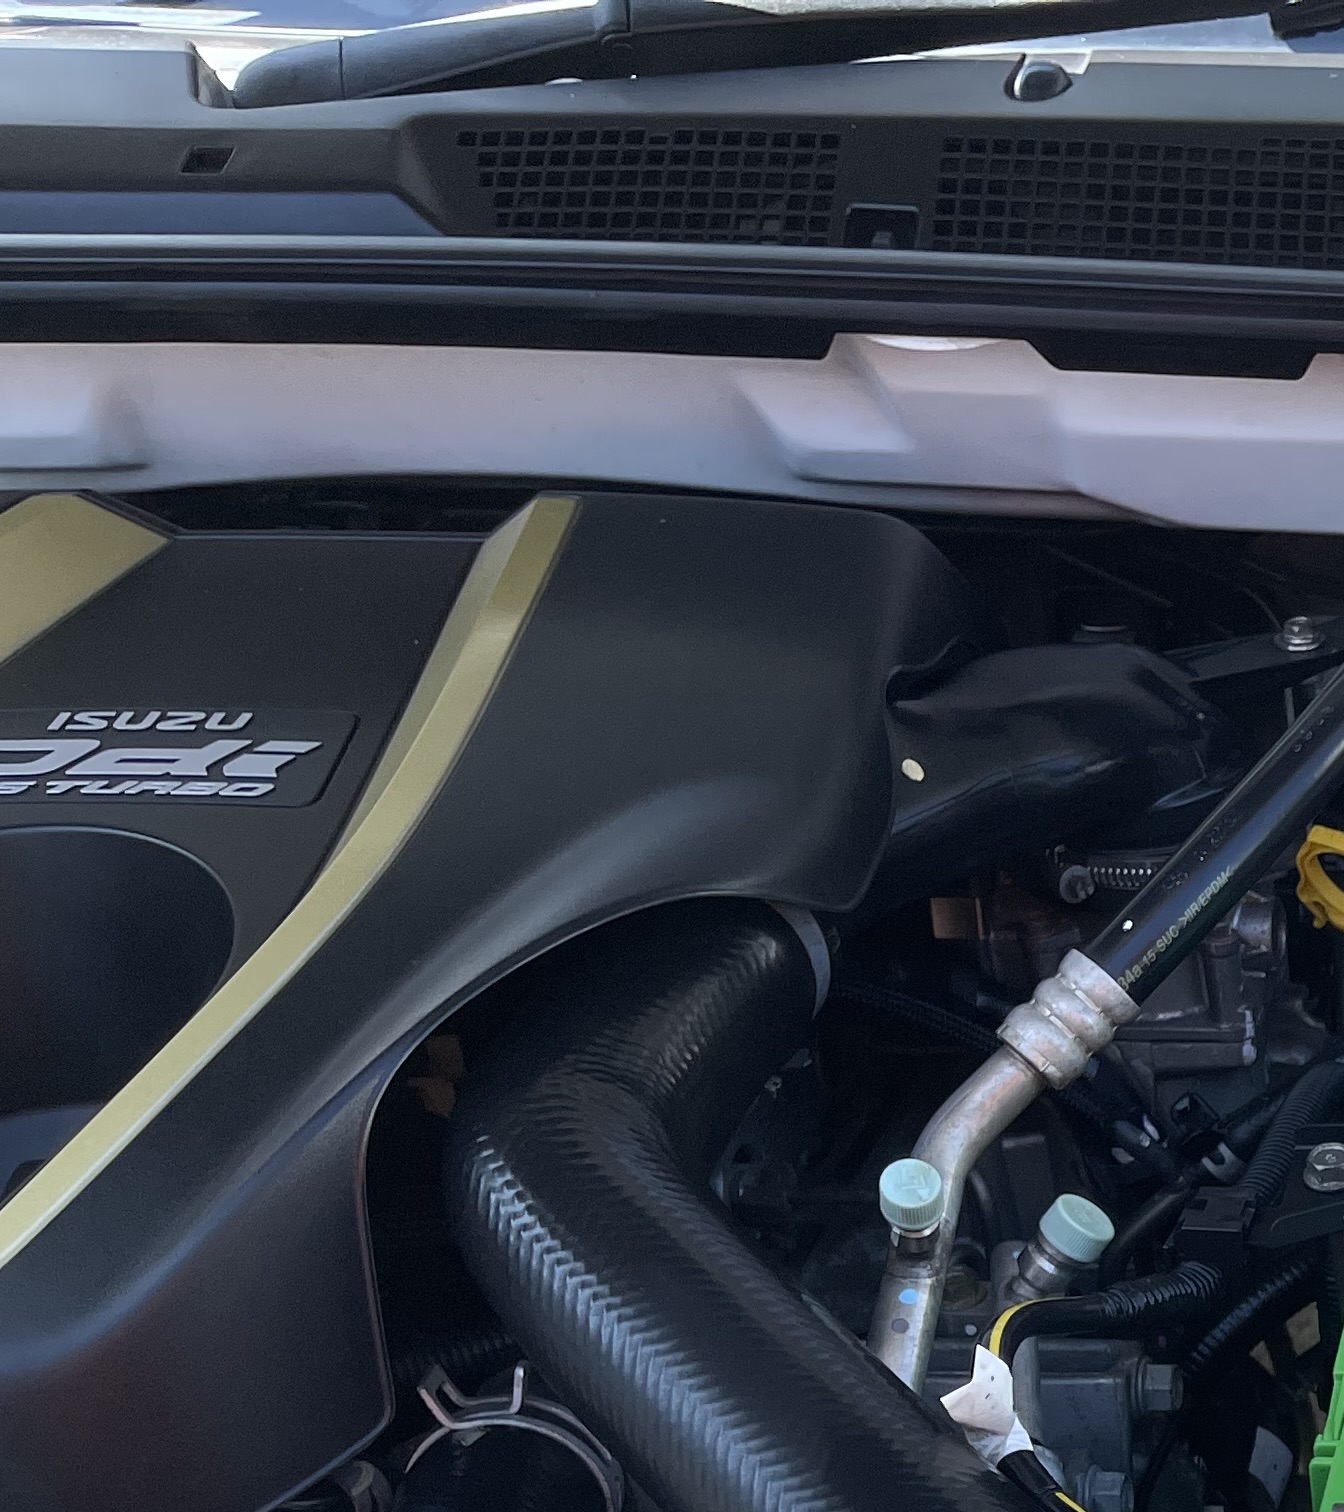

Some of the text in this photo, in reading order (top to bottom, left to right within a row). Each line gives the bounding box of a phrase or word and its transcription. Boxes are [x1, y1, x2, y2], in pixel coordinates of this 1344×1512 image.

[47, 711, 254, 732] ISUZU
[46, 779, 275, 797] TURBO
[1141, 949, 1157, 966] 15
[1153, 924, 1182, 953] SUC
